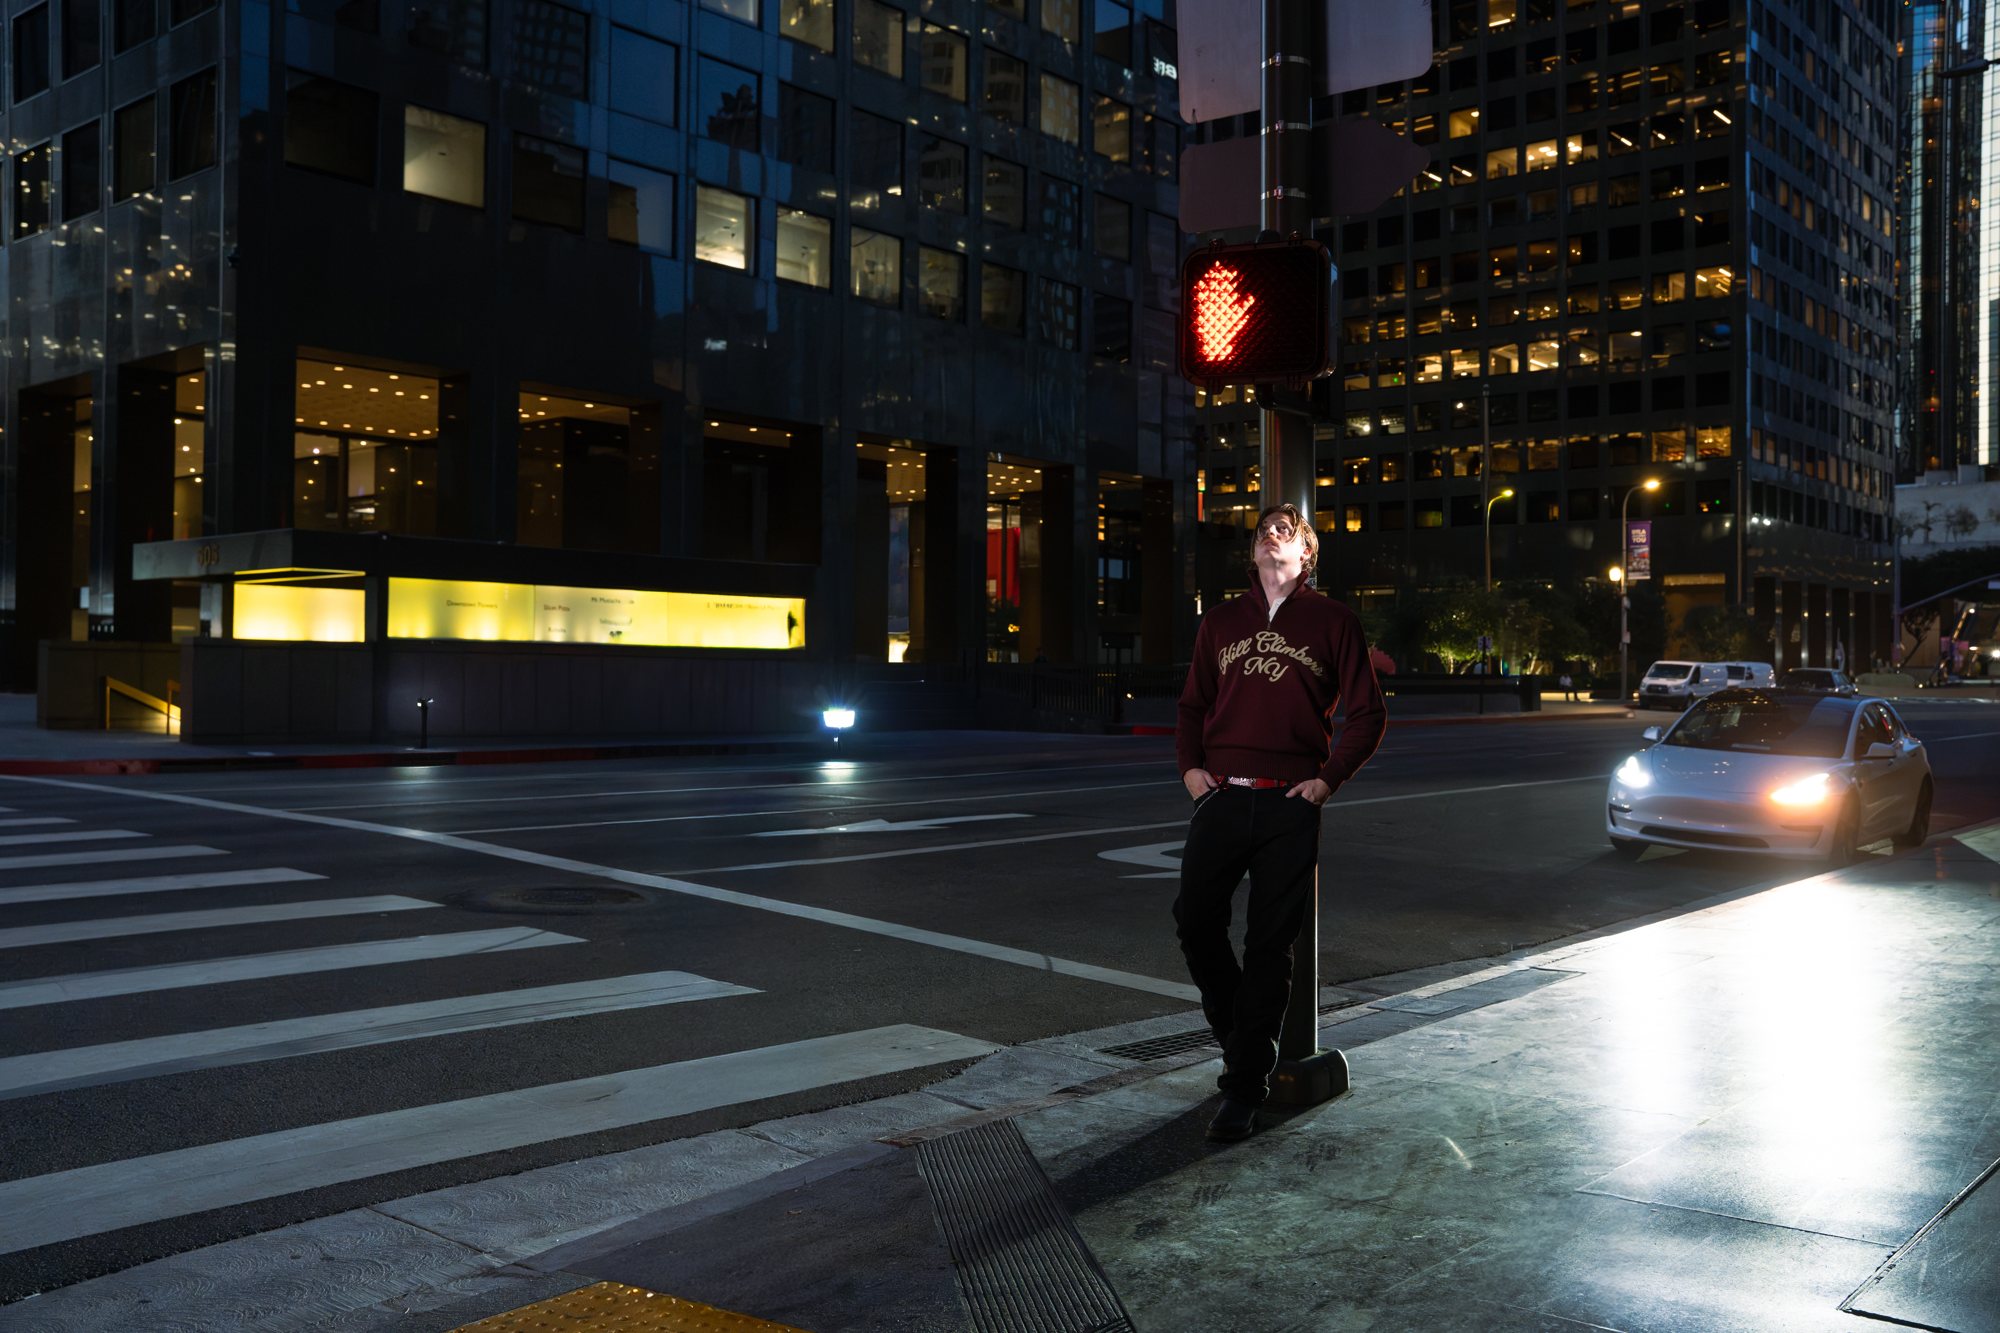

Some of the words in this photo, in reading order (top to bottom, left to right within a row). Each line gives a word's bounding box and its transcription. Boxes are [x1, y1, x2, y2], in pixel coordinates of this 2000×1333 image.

[1218, 637, 1253, 675] Hill
[1255, 631, 1323, 676] Climbers
[1243, 656, 1289, 682] NY
